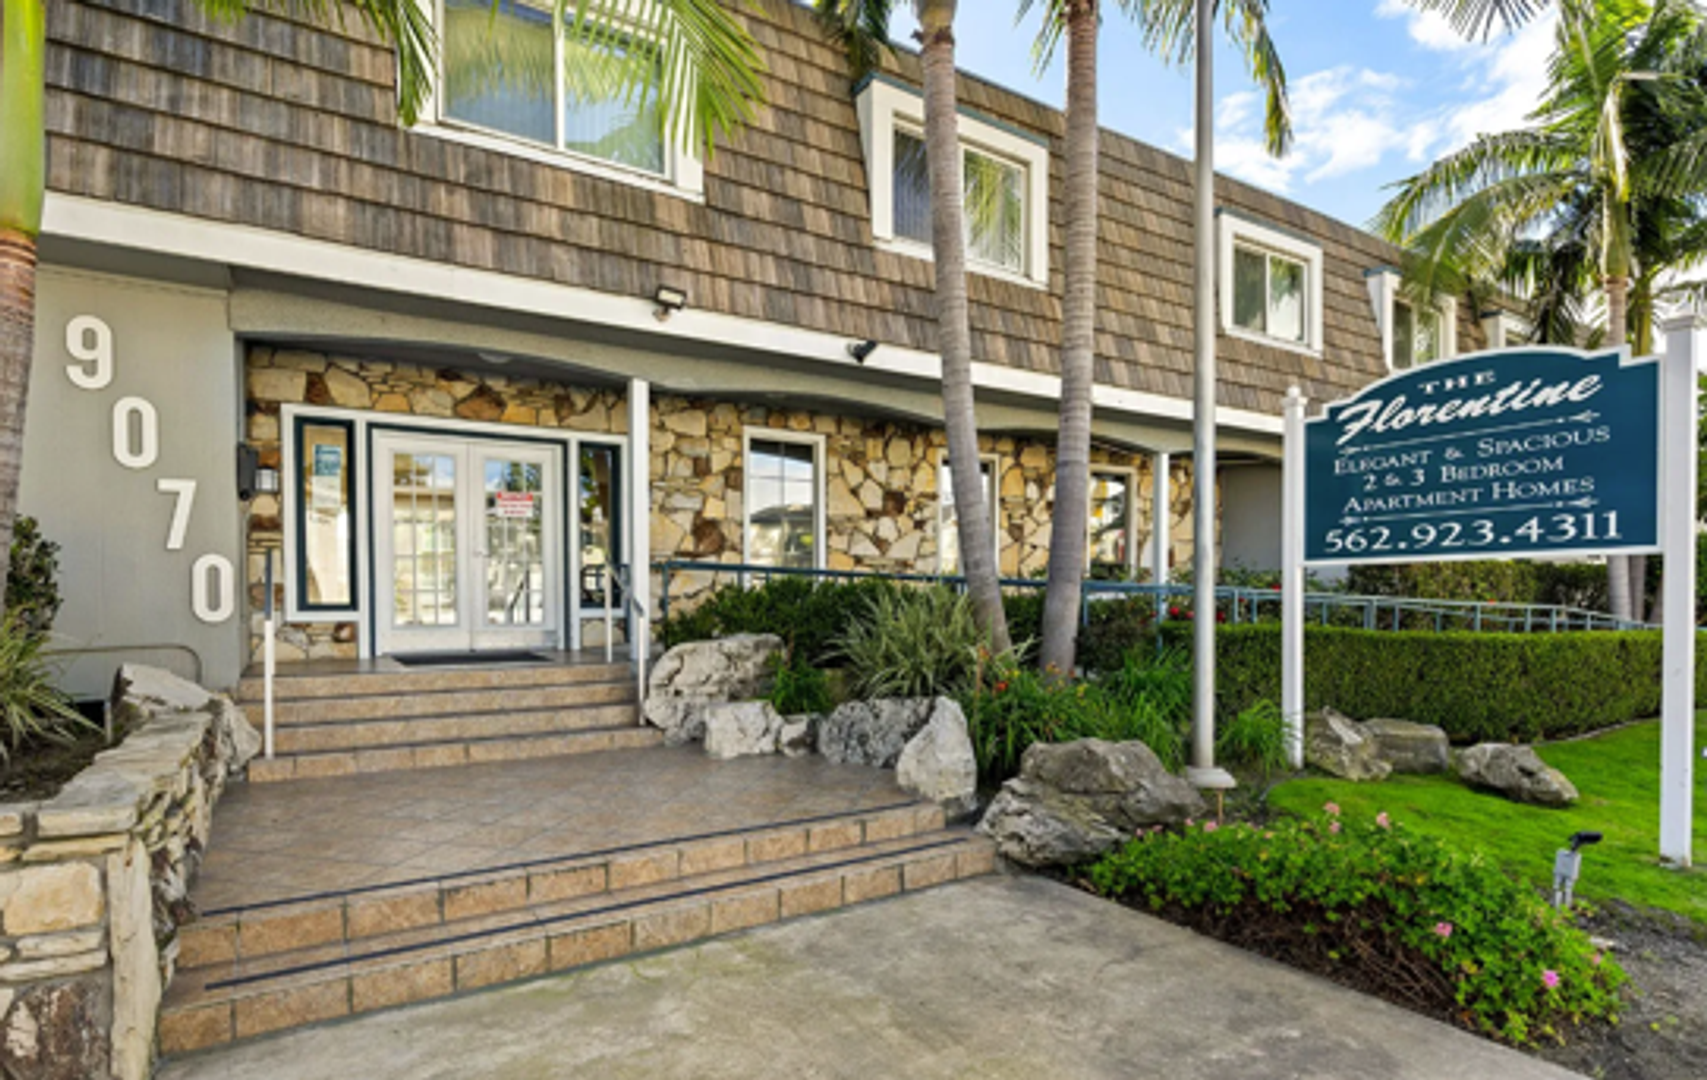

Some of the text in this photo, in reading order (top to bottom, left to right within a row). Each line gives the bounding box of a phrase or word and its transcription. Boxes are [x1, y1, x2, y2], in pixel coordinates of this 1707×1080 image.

[1417, 370, 1496, 395] THE
[1335, 374, 1603, 446] Florentine
[65, 314, 234, 623] 9070
[1334, 425, 1611, 475] ELEGANT & SPACIOUS
[1342, 476, 1595, 514] APARTMENT HOMES
[1363, 455, 1564, 492] 2 & 3 BEDROOM
[1324, 510, 1623, 553] 562.923.4311
